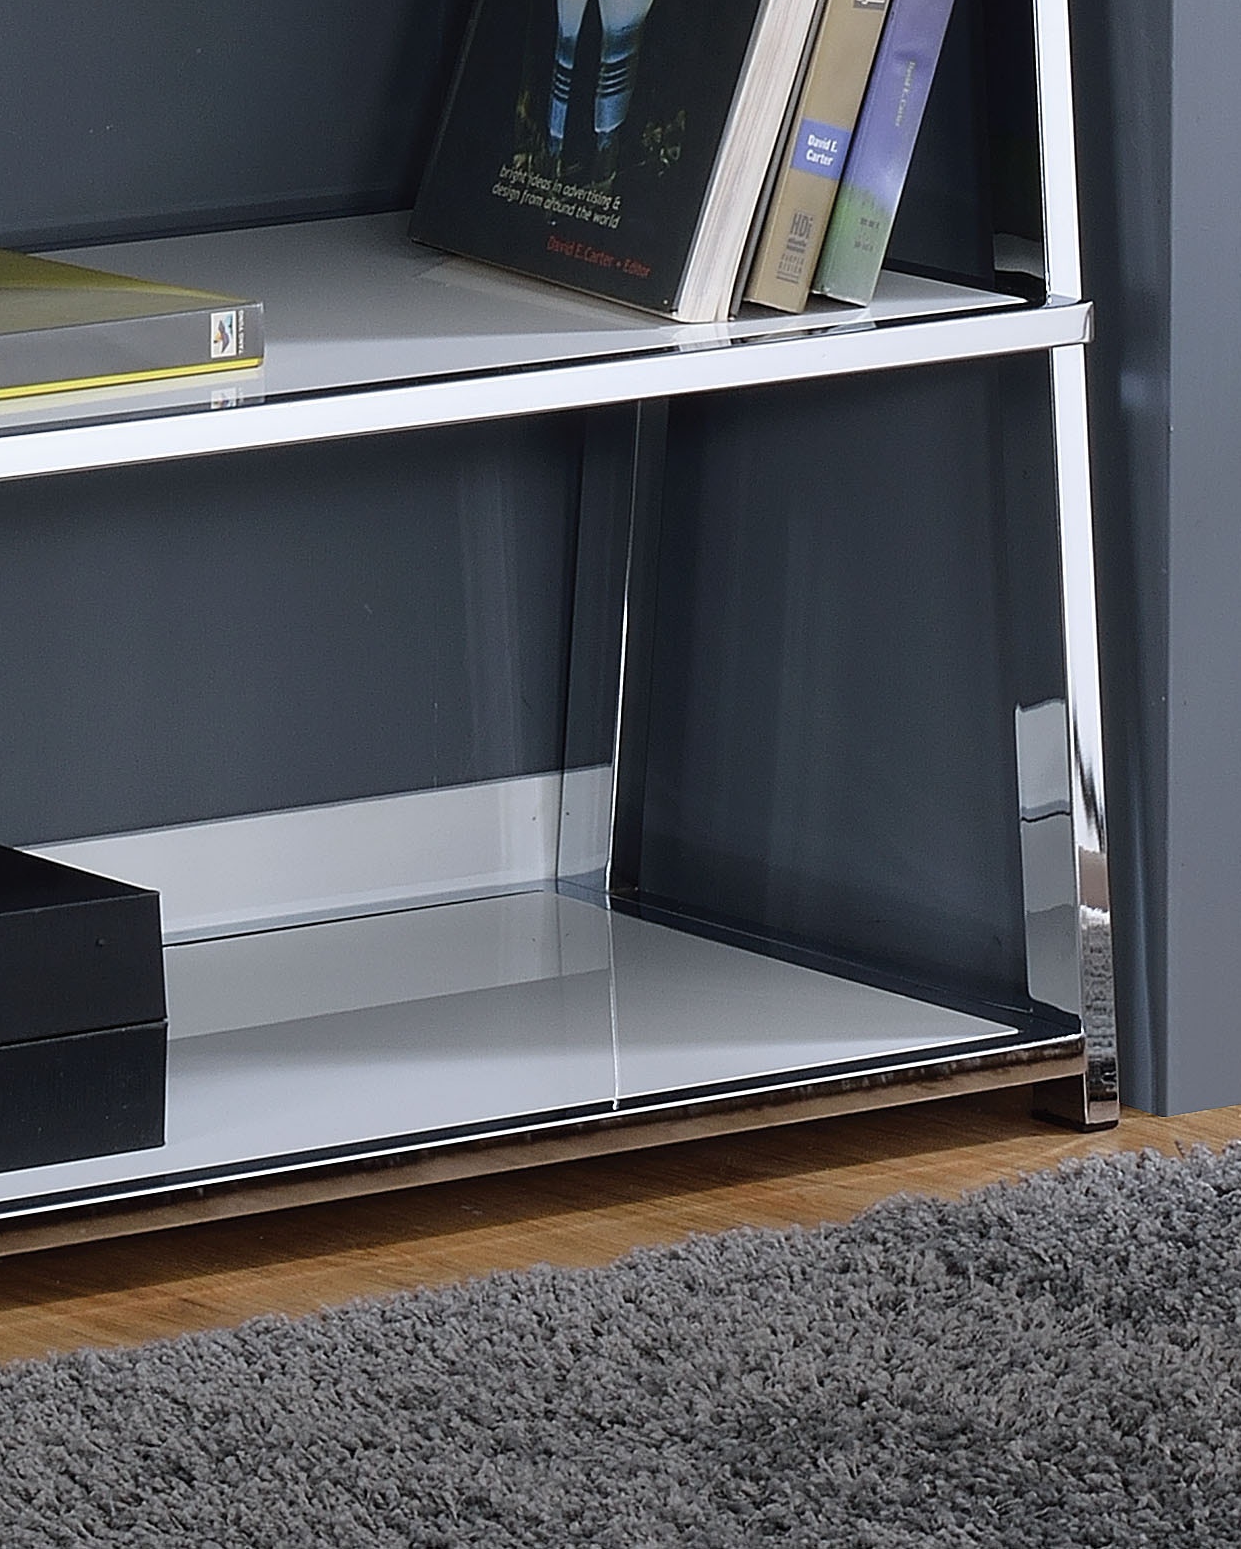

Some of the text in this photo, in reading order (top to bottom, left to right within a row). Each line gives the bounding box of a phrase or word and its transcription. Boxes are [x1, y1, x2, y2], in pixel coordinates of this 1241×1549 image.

[805, 149, 834, 166] Carter
[807, 134, 838, 153] David E.
[498, 164, 527, 184] bright
[552, 179, 562, 193] in
[562, 182, 613, 210] advertising
[491, 182, 621, 229] design from around the world
